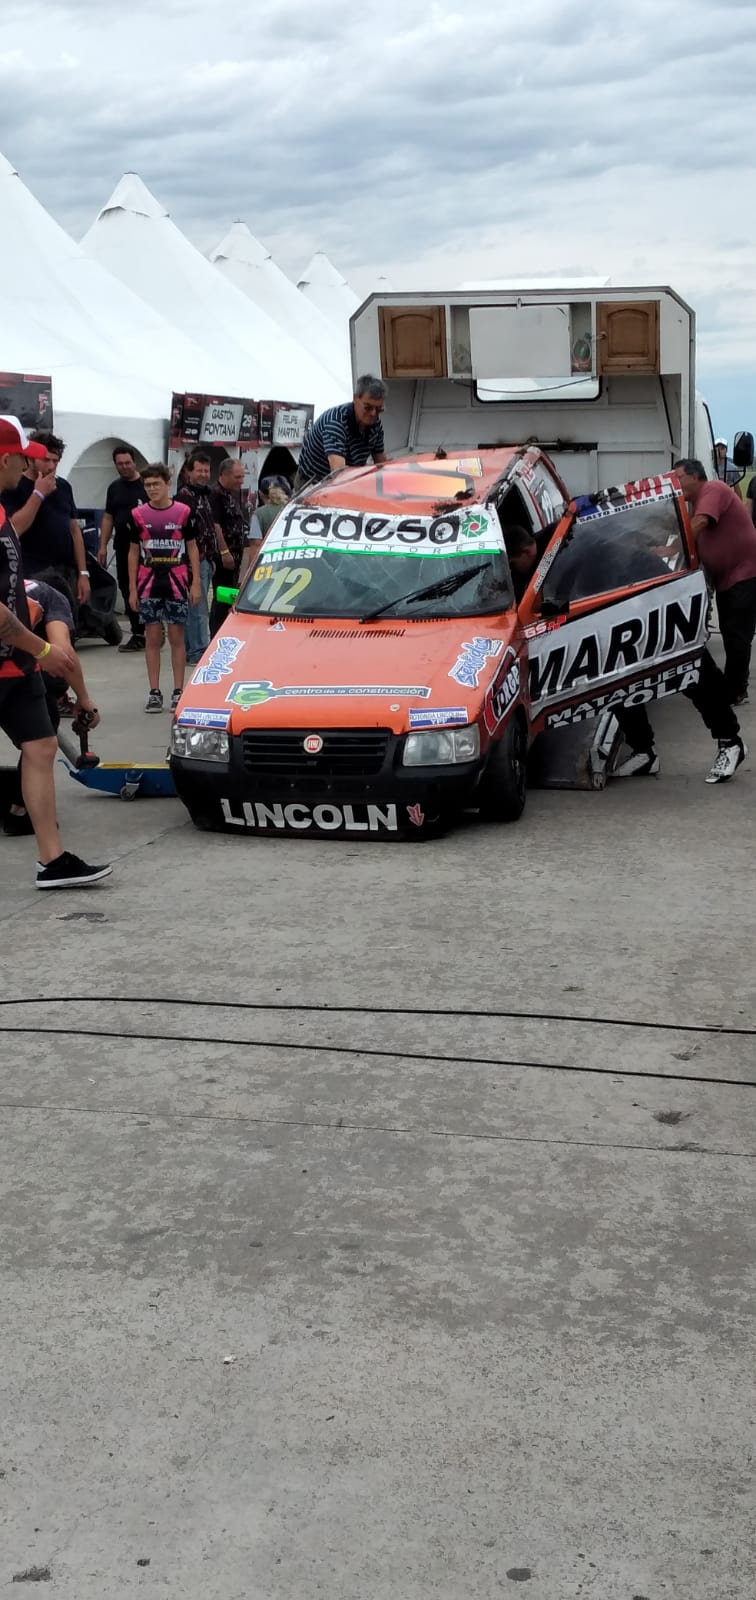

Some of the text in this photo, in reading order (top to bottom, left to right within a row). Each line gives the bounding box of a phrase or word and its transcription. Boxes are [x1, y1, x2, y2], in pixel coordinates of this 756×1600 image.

[282, 507, 460, 544] fadesa
[262, 549, 323, 564] ARDESI
[281, 539, 486, 555] EXTINTORES
[253, 566, 272, 581] C1
[258, 567, 312, 613] 12
[529, 592, 702, 700] MARIN
[348, 687, 425, 696] construcción
[220, 798, 398, 831] LINCOLN
